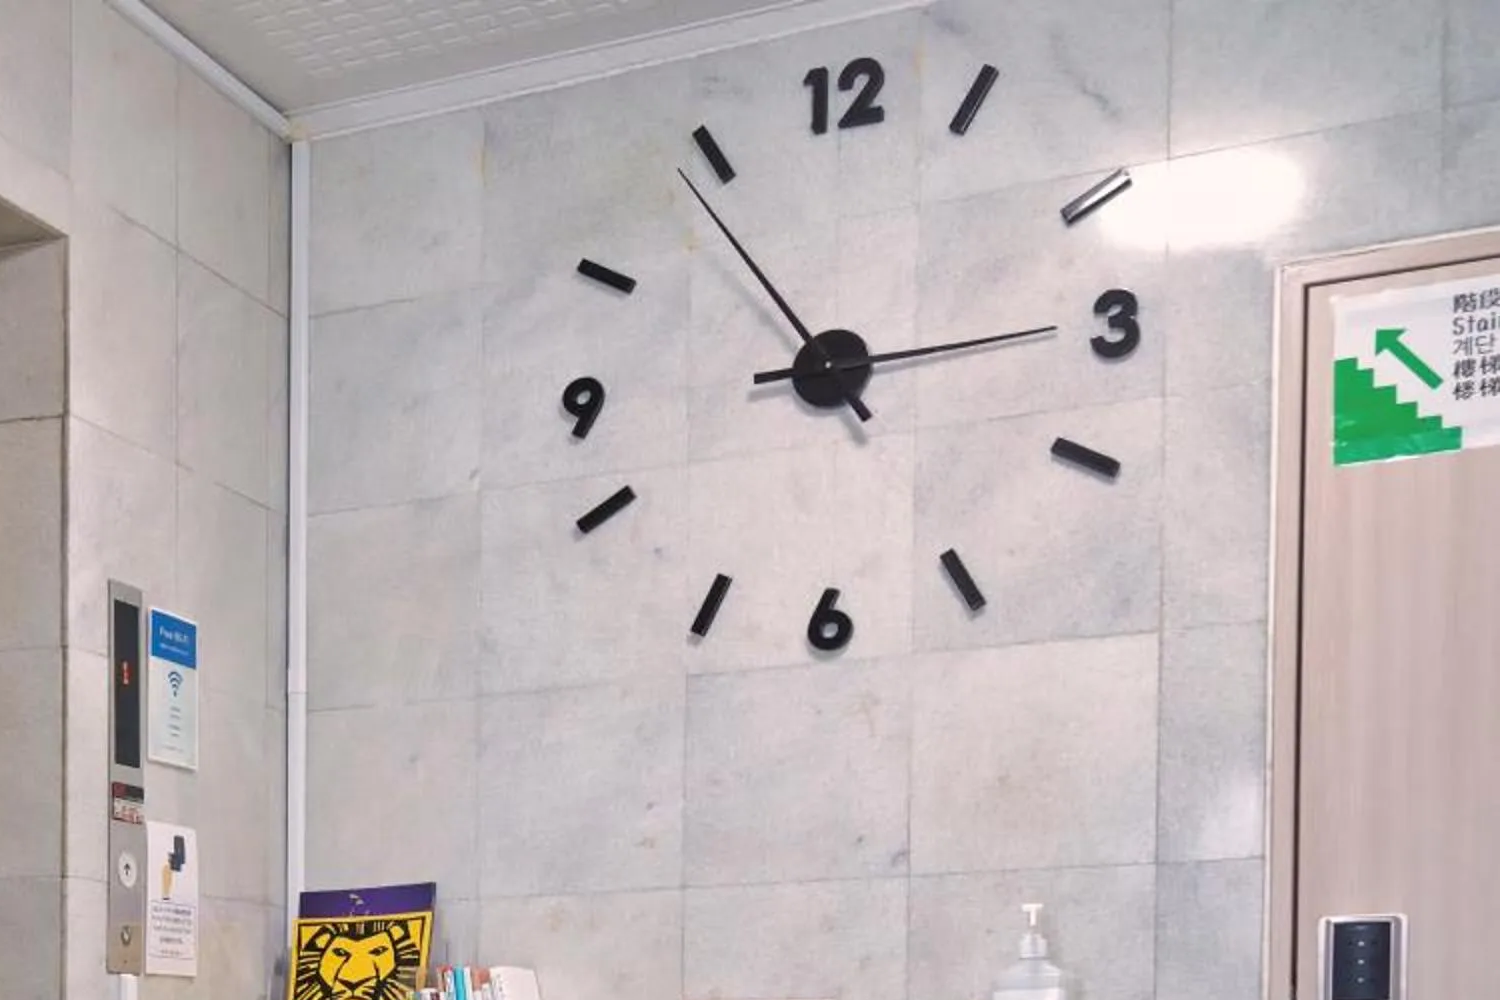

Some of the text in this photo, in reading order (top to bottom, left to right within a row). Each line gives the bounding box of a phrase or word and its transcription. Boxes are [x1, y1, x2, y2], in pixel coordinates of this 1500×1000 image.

[803, 57, 885, 135] 12
[1090, 288, 1141, 359] 3
[1452, 311, 1500, 336] Stai
[1452, 333, 1496, 356] 계단
[562, 376, 606, 440] 9
[807, 587, 854, 651] 6
